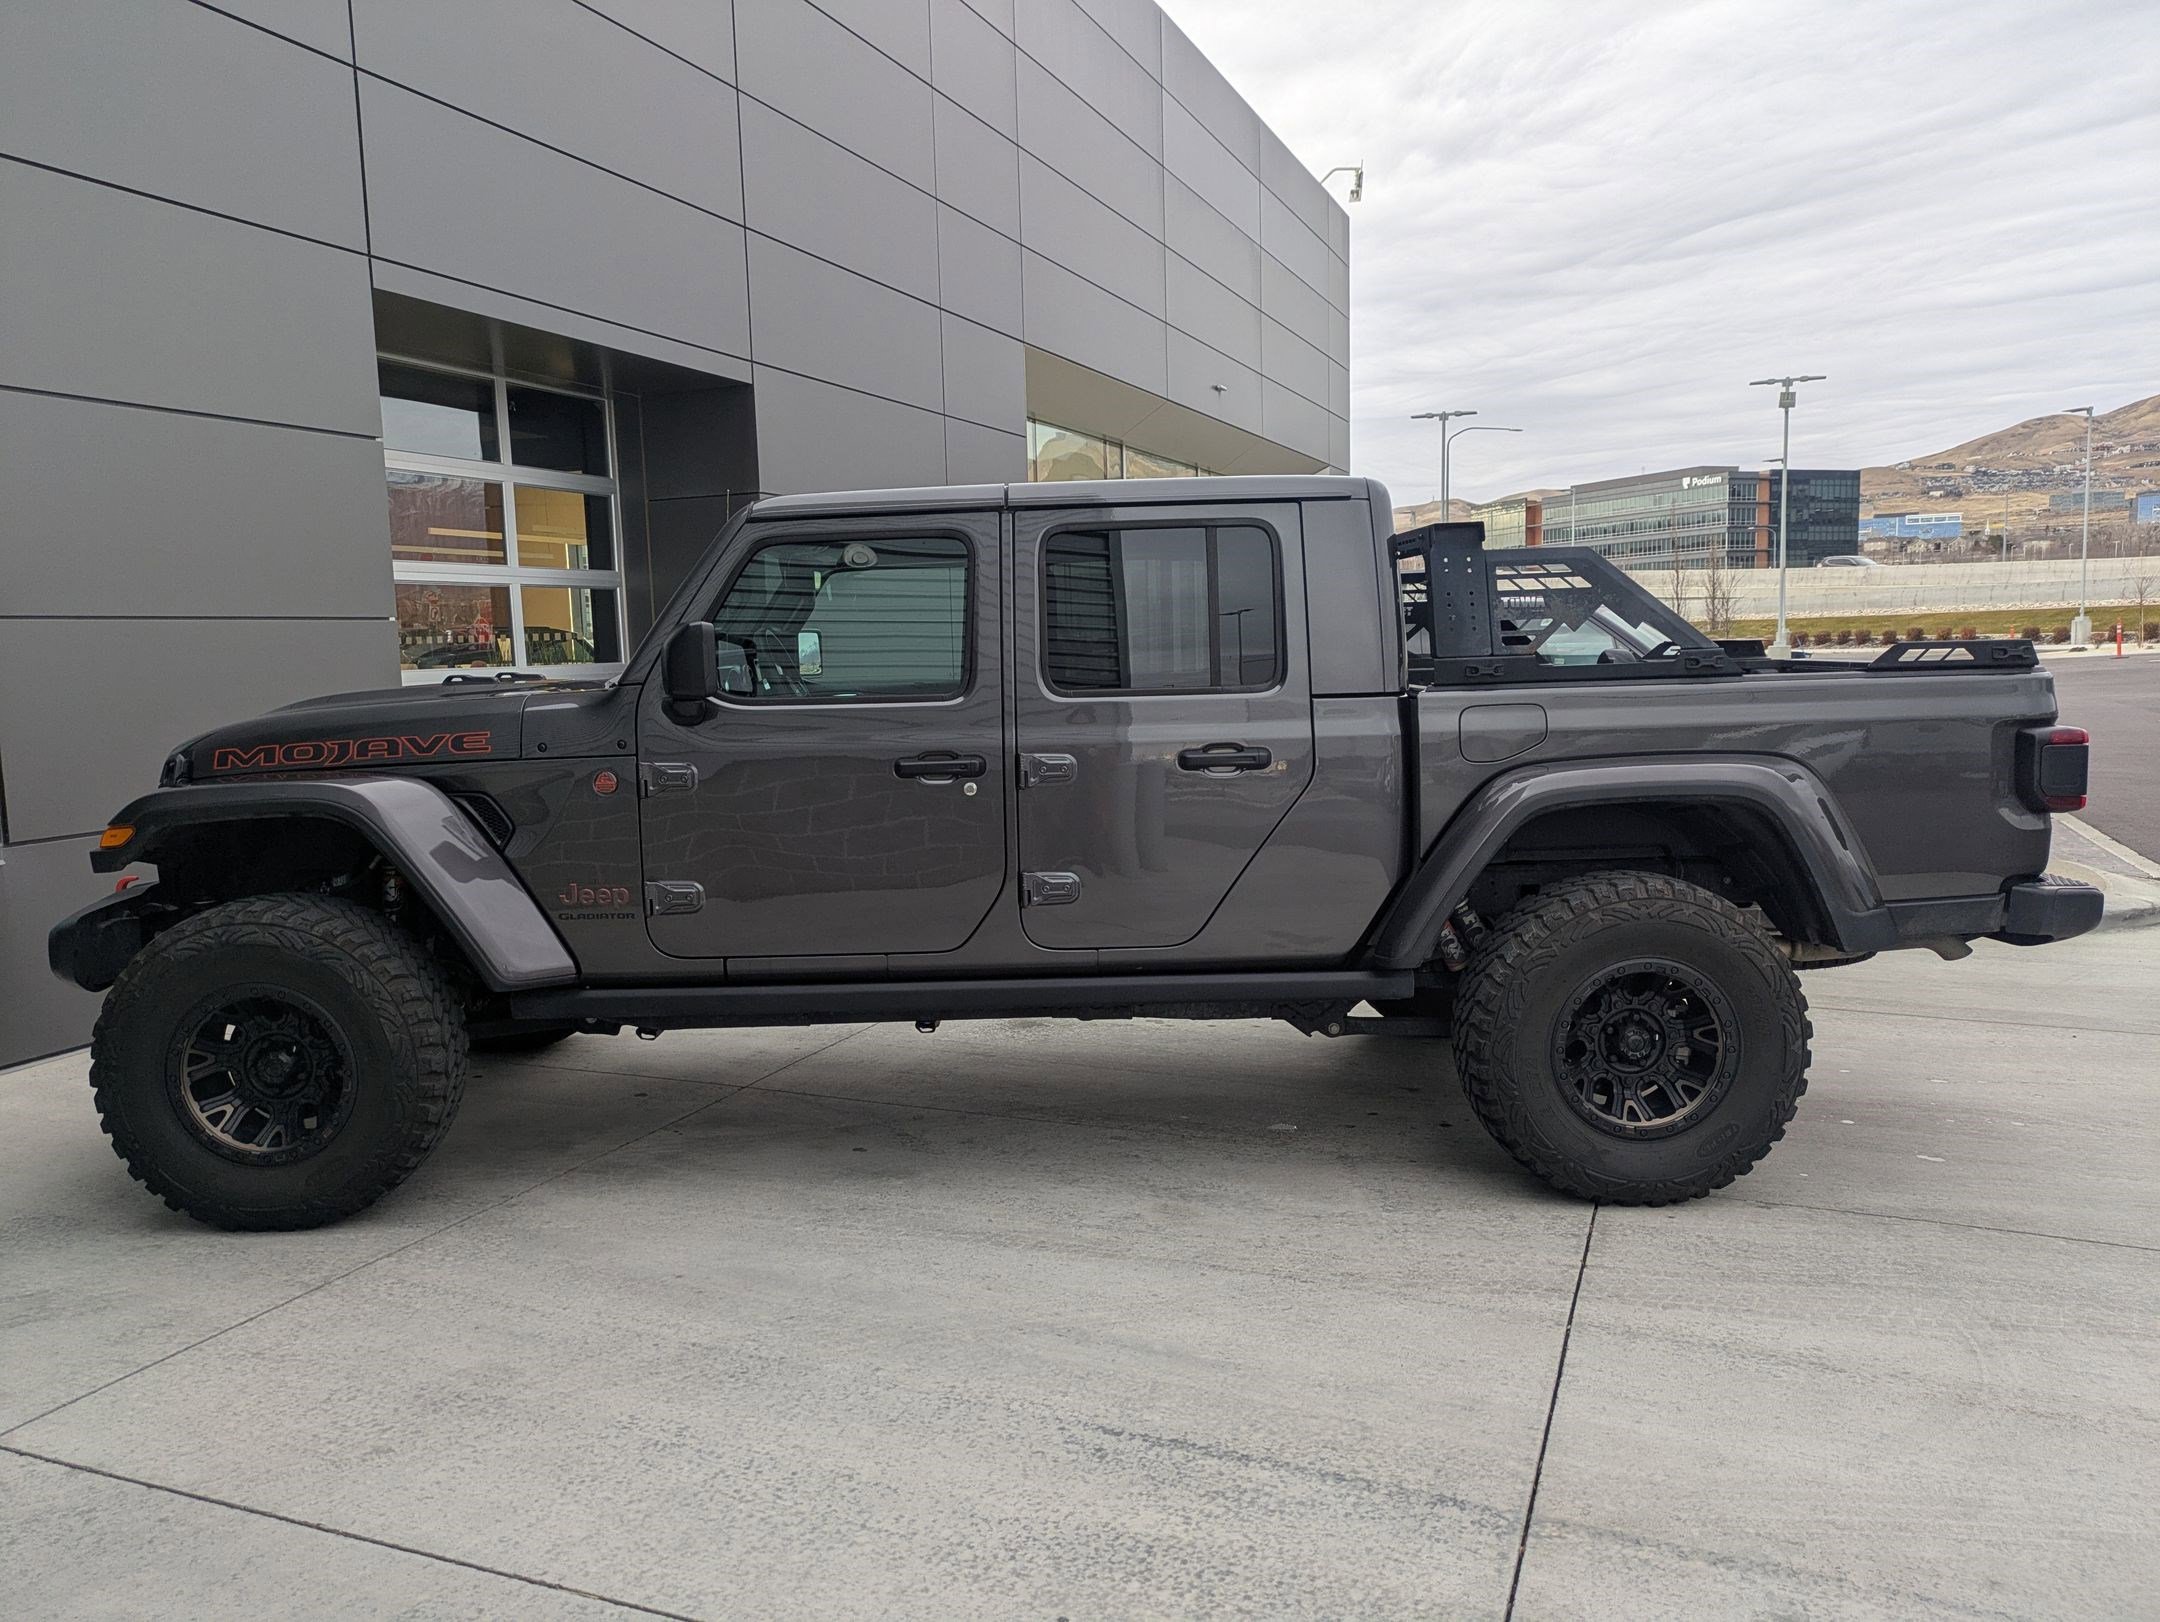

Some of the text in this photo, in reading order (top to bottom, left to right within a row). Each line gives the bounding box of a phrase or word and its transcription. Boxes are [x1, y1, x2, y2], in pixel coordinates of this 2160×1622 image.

[1692, 475, 1722, 486] Podium
[213, 731, 491, 770] MOJAVE
[559, 883, 630, 909] Jeep
[558, 912, 635, 920] GLADIATOR
